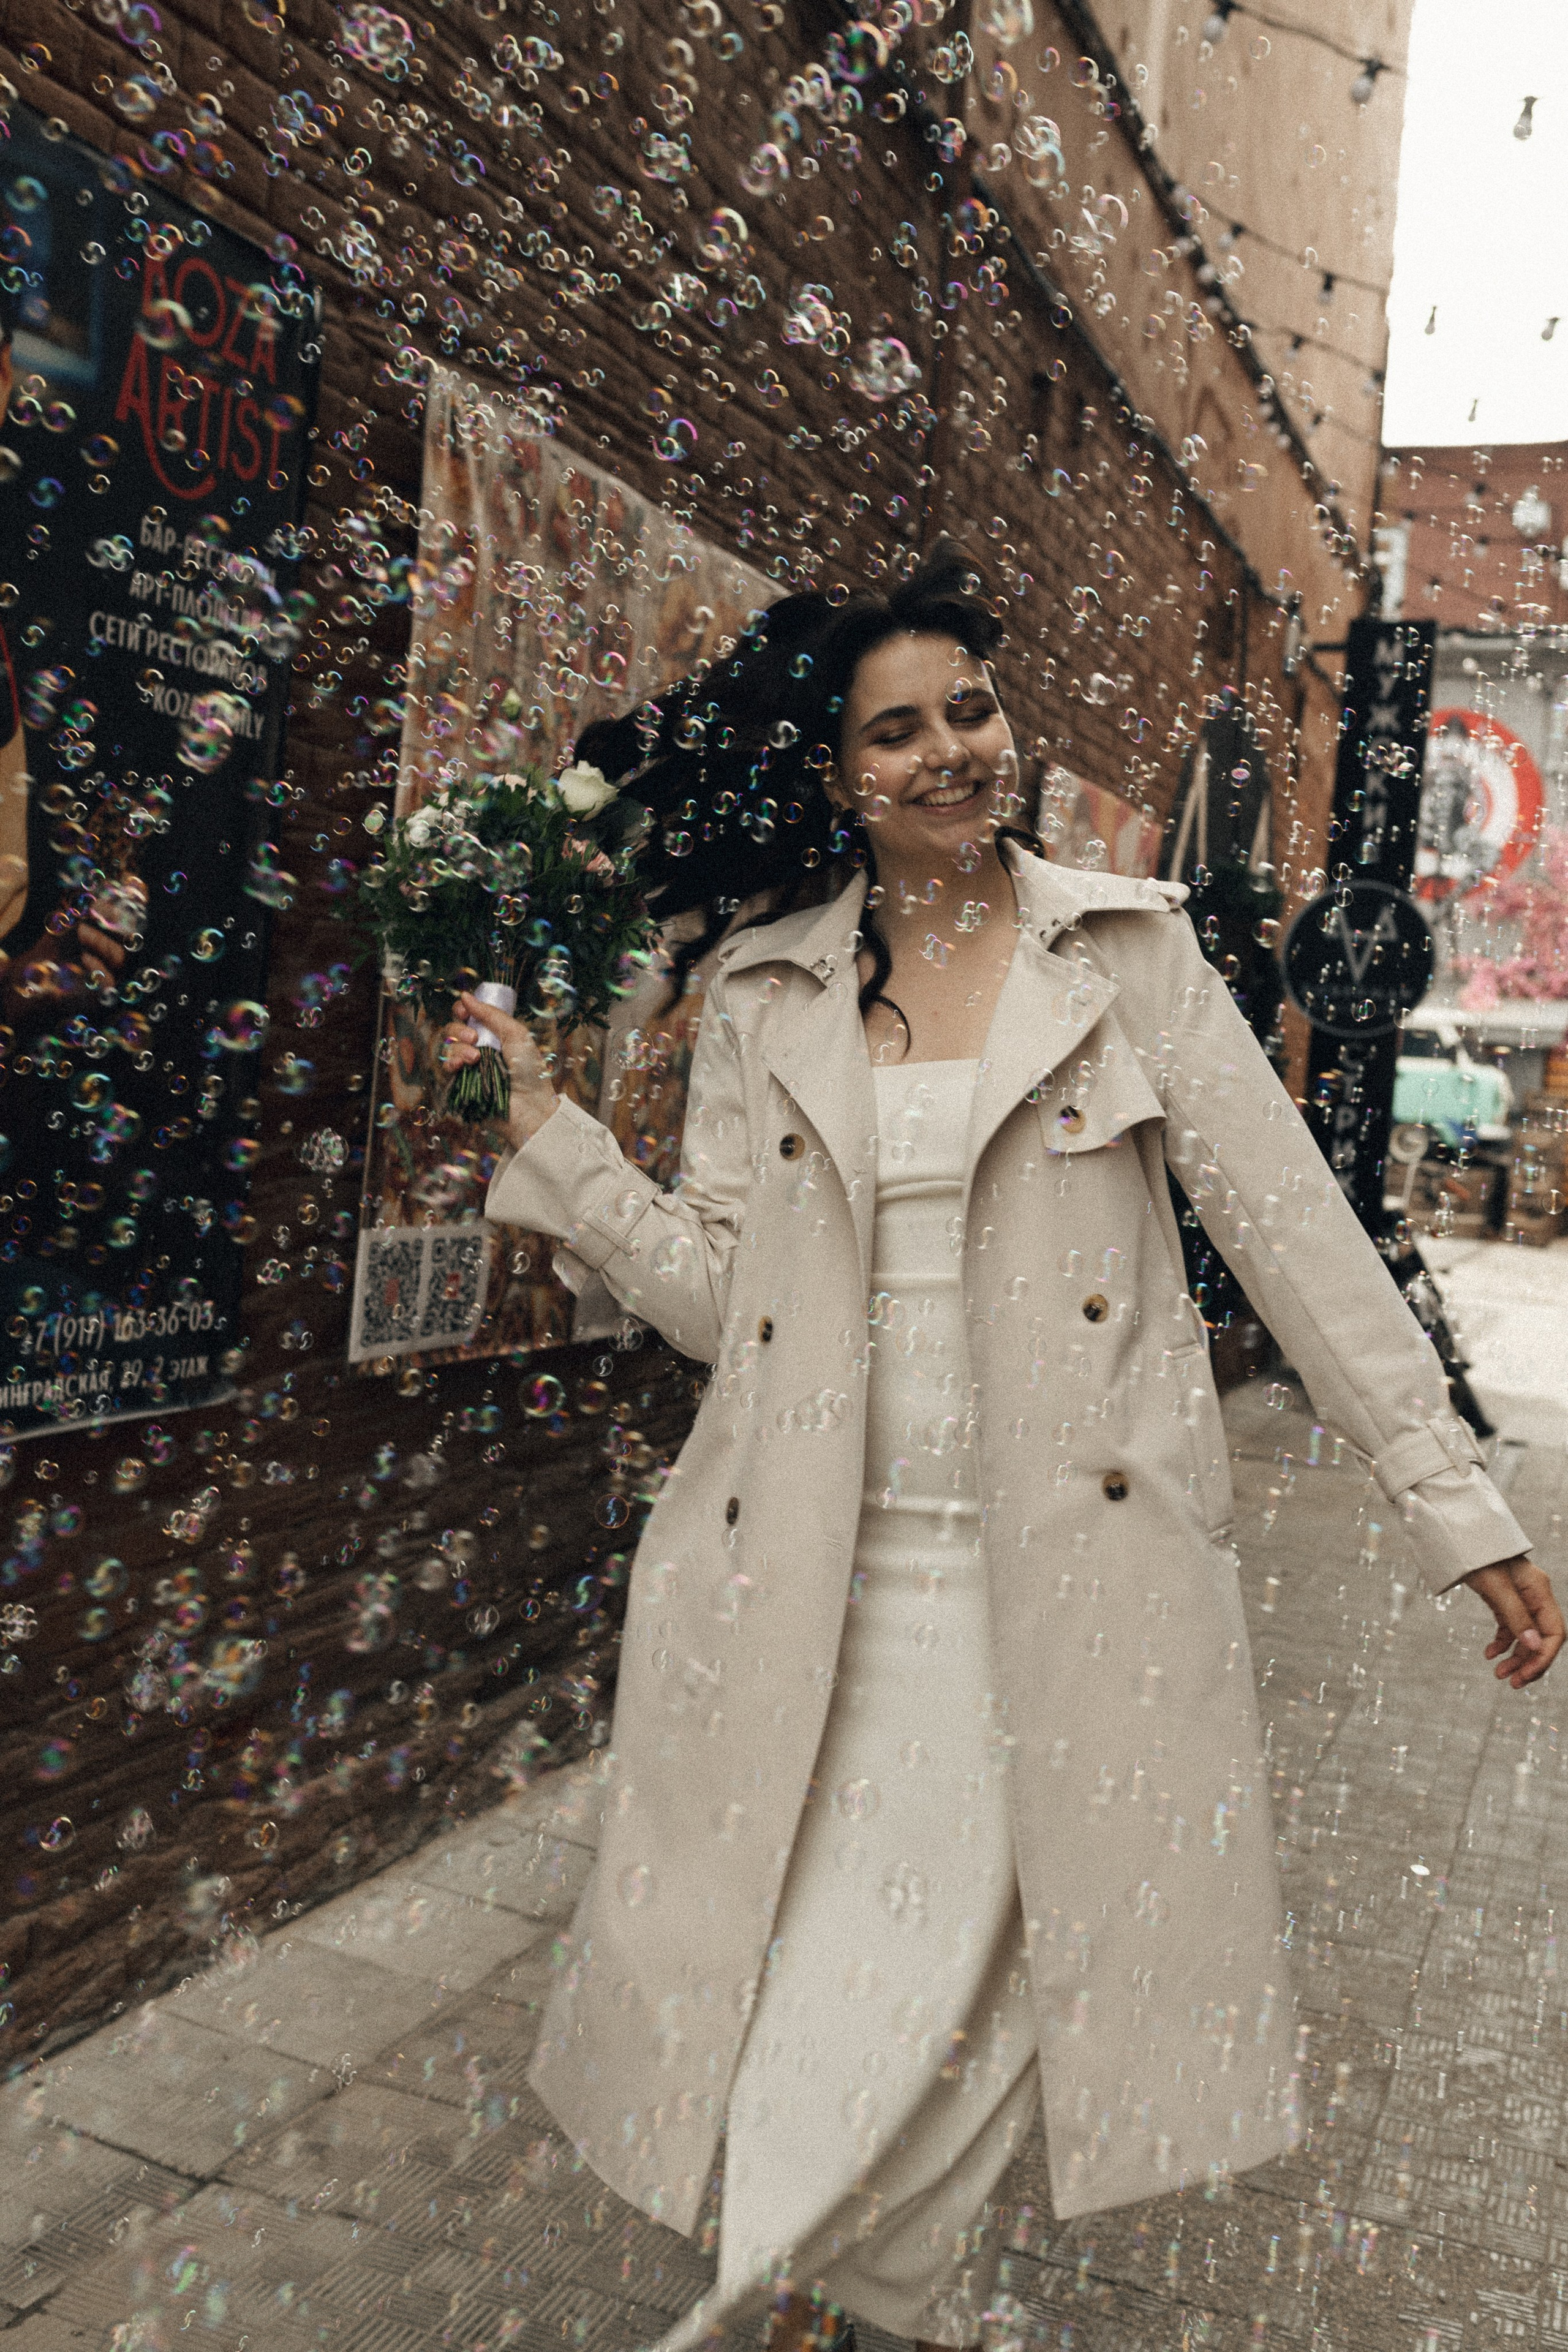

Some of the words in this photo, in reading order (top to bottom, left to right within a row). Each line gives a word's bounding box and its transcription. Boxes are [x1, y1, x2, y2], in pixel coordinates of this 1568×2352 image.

[115, 333, 293, 500] ARTIST
[140, 516, 276, 588] БАР-РЕСТН
[89, 611, 140, 652] СЕТИ
[129, 570, 271, 643] АРТ-ПЛОЩ
[167, 1355, 208, 1381] ЭТАЖ
